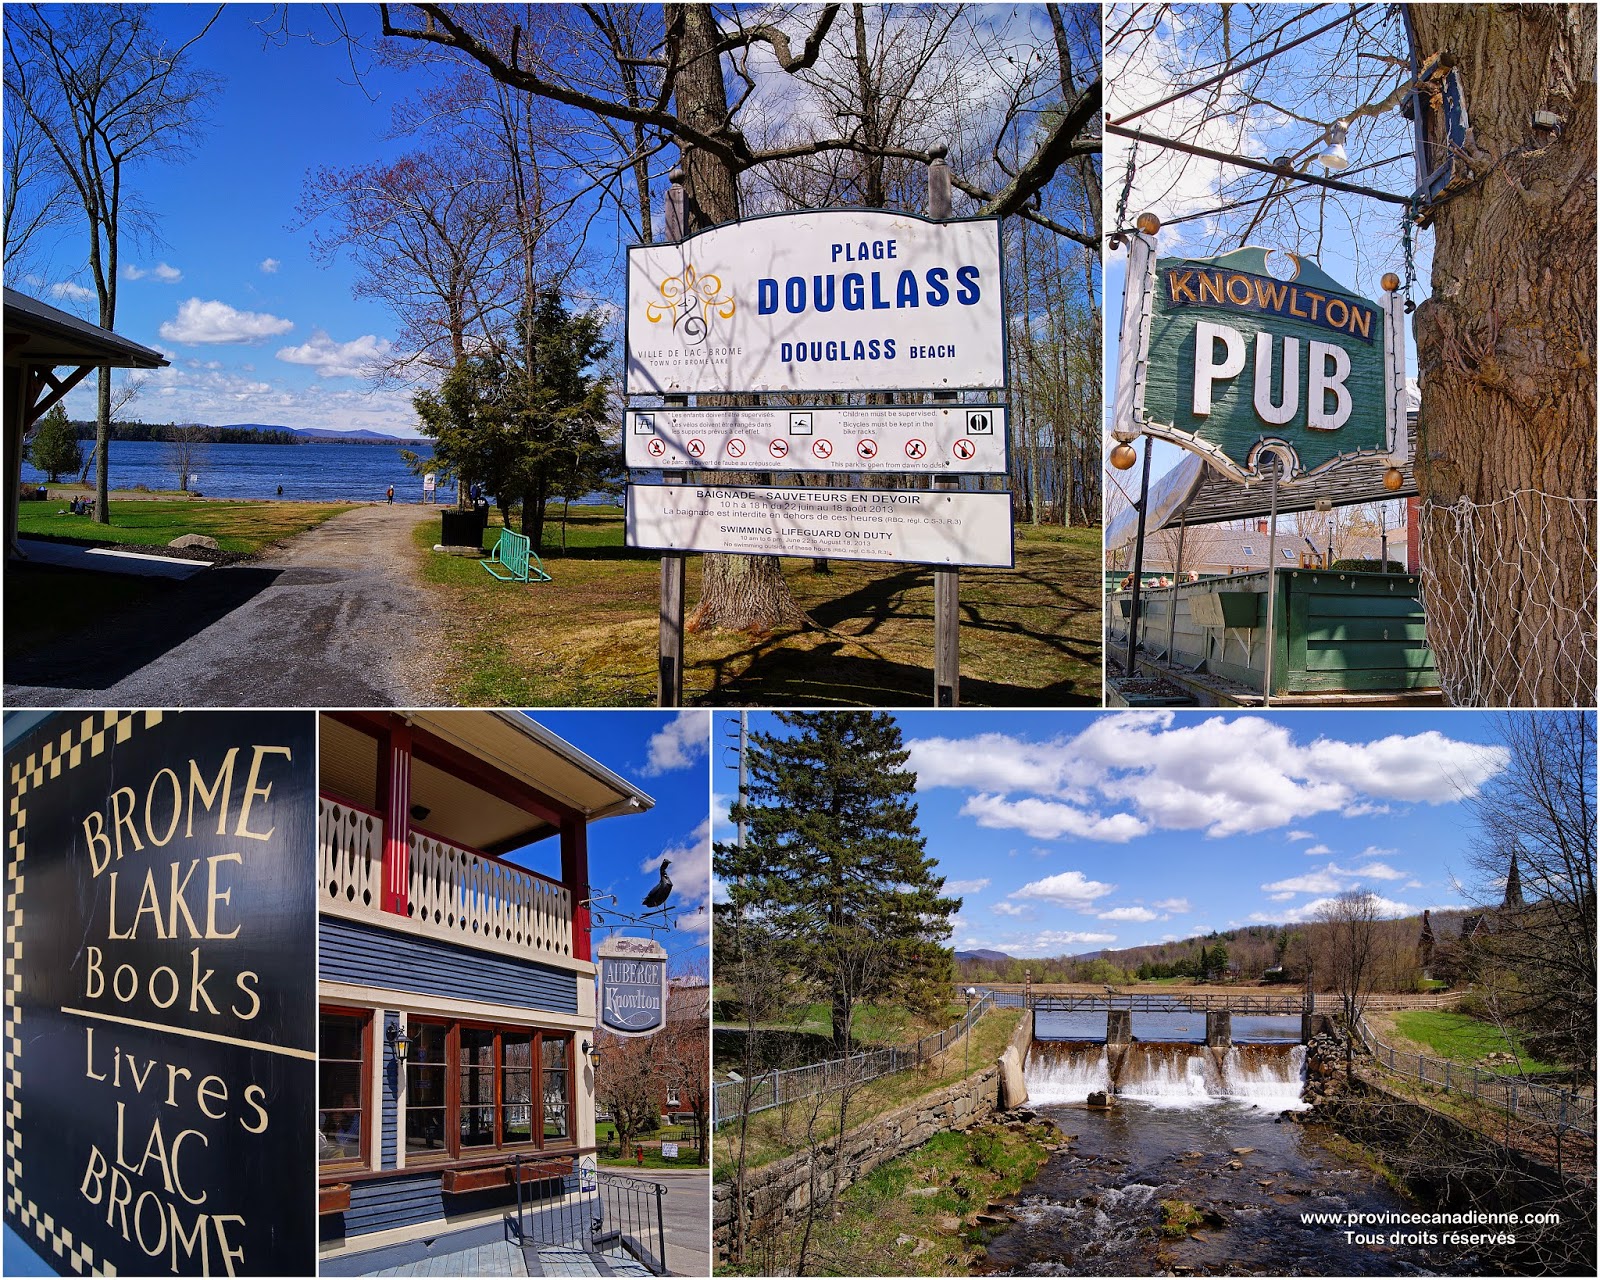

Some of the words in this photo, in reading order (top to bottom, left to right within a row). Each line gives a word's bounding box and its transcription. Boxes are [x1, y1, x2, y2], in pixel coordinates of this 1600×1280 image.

[832, 239, 898, 262] PLAGE
[758, 265, 981, 316] DOUGLASS
[1169, 270, 1372, 338] KNOWLTON
[684, 347, 742, 357] LAC-BROME
[781, 338, 896, 363] DOUGLASS
[910, 344, 956, 360] BEACH
[1192, 320, 1352, 432] PUB
[676, 508, 714, 517] baignade
[732, 509, 766, 518] interdite
[783, 512, 814, 520] dehors
[696, 490, 755, 499] BAIGNADE
[766, 492, 847, 502] SAUVETEURS
[872, 495, 920, 504] DEVOIR
[720, 526, 772, 535] SWIMMING
[781, 529, 841, 538] LIFEGUARD
[82, 745, 292, 878] BROME
[108, 852, 243, 939] LAKE
[86, 946, 260, 1020] Books
[606, 963, 659, 984] AUBERGE
[604, 987, 660, 1012] Knowlton
[86, 1028, 269, 1134] Livres
[116, 1102, 208, 1204] LAC
[80, 1144, 246, 1277] BROME
